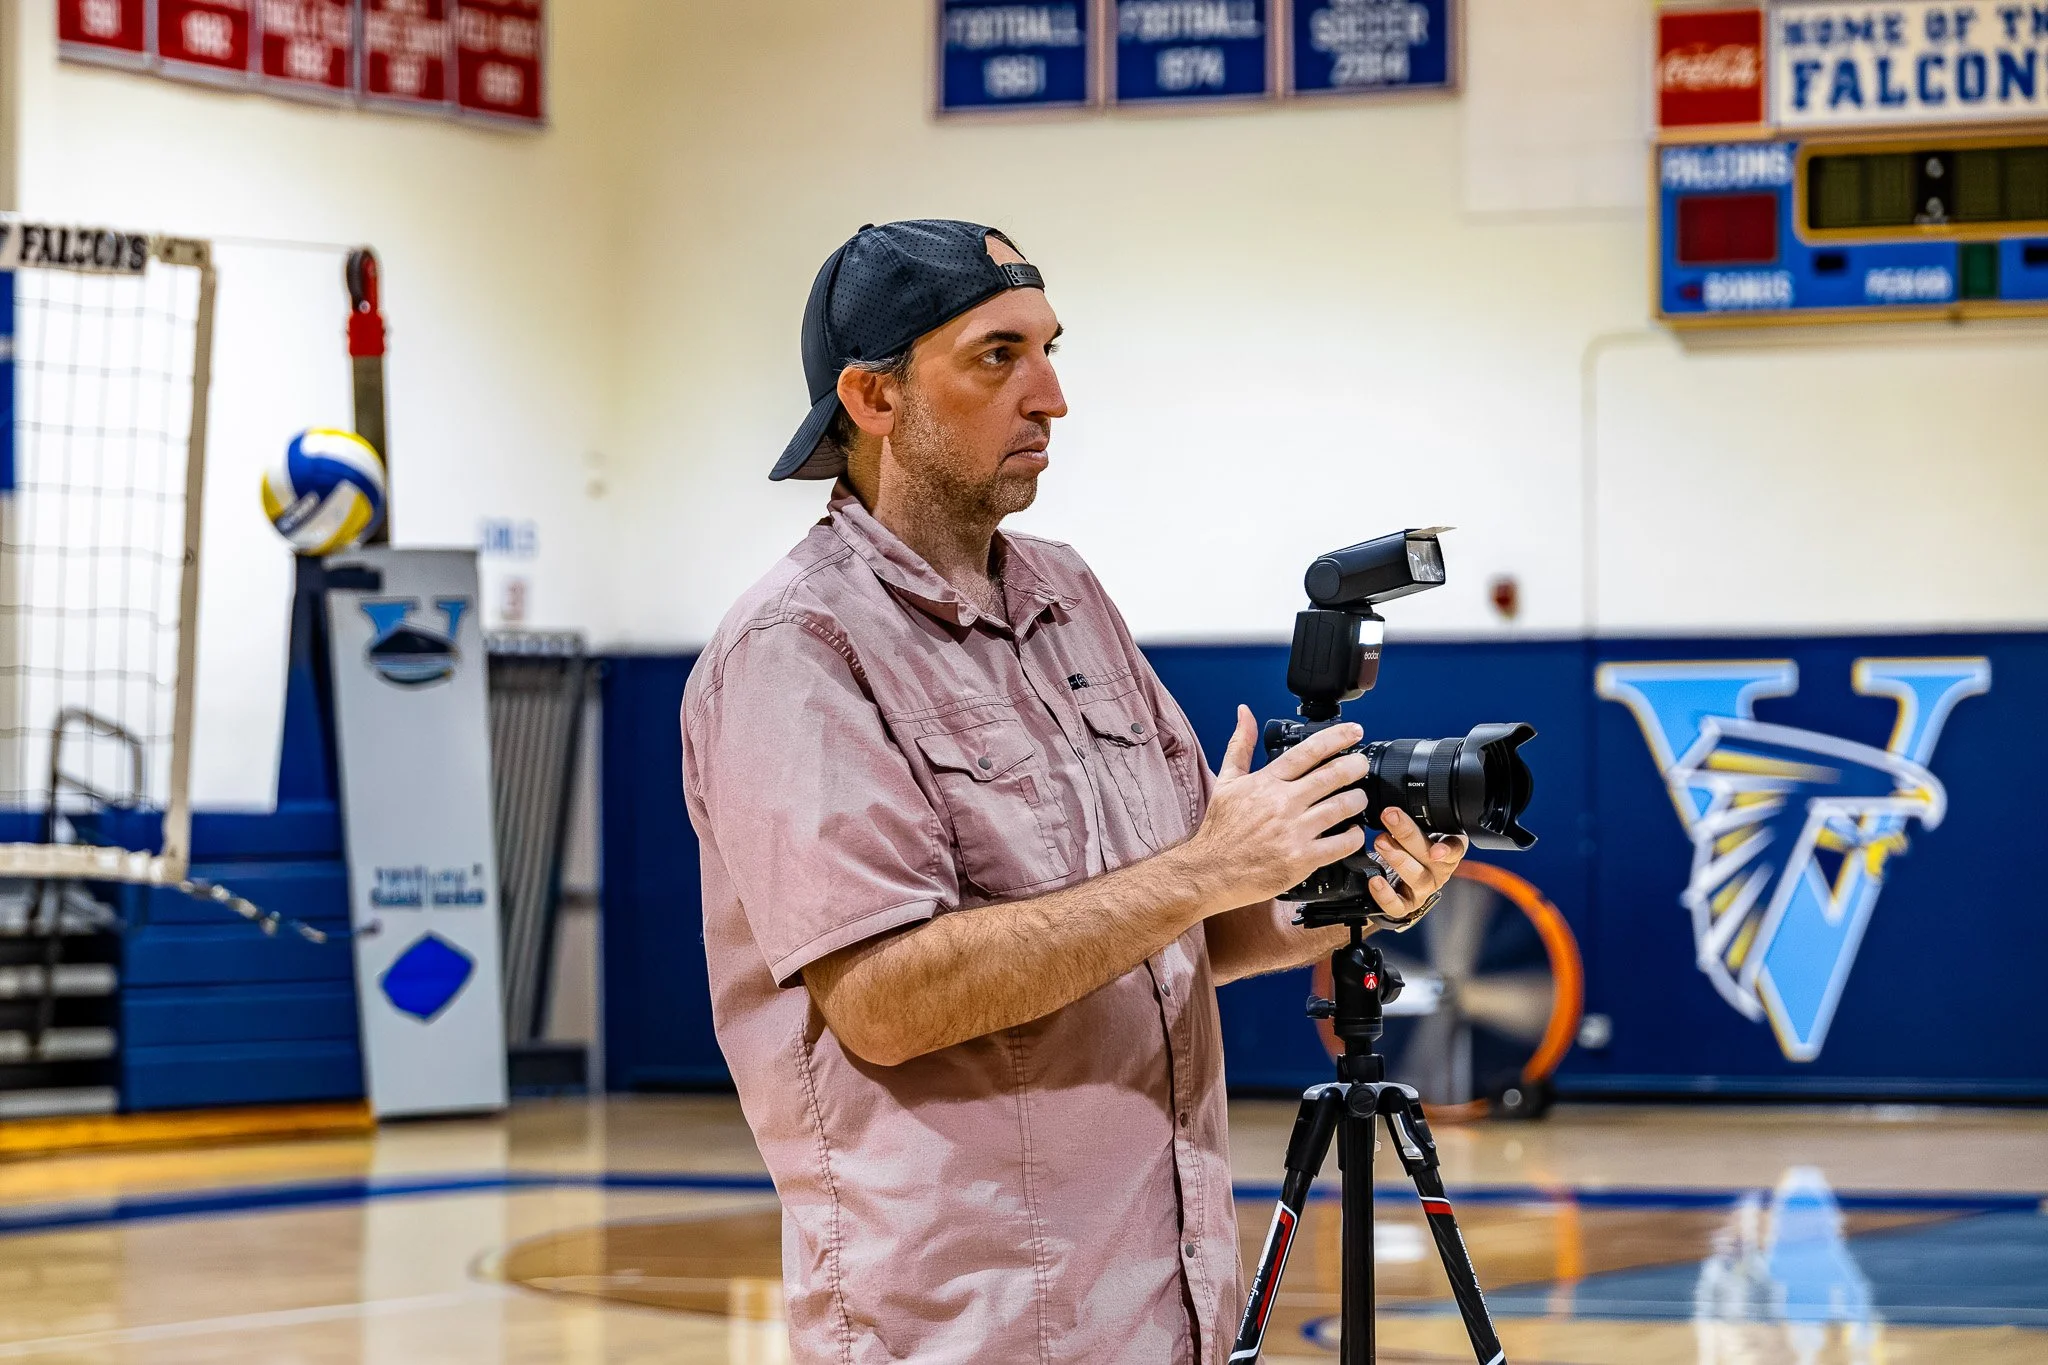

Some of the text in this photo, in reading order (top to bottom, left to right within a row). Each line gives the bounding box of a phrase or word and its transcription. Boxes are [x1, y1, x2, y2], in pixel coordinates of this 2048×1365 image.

[1783, 12, 1903, 46] HOME
[1924, 9, 1974, 41] OF
[1791, 51, 2048, 110] FALCON
[1663, 147, 1792, 190] FALCONS
[1704, 270, 1792, 308] BONUS
[1364, 650, 1379, 660] Godox
